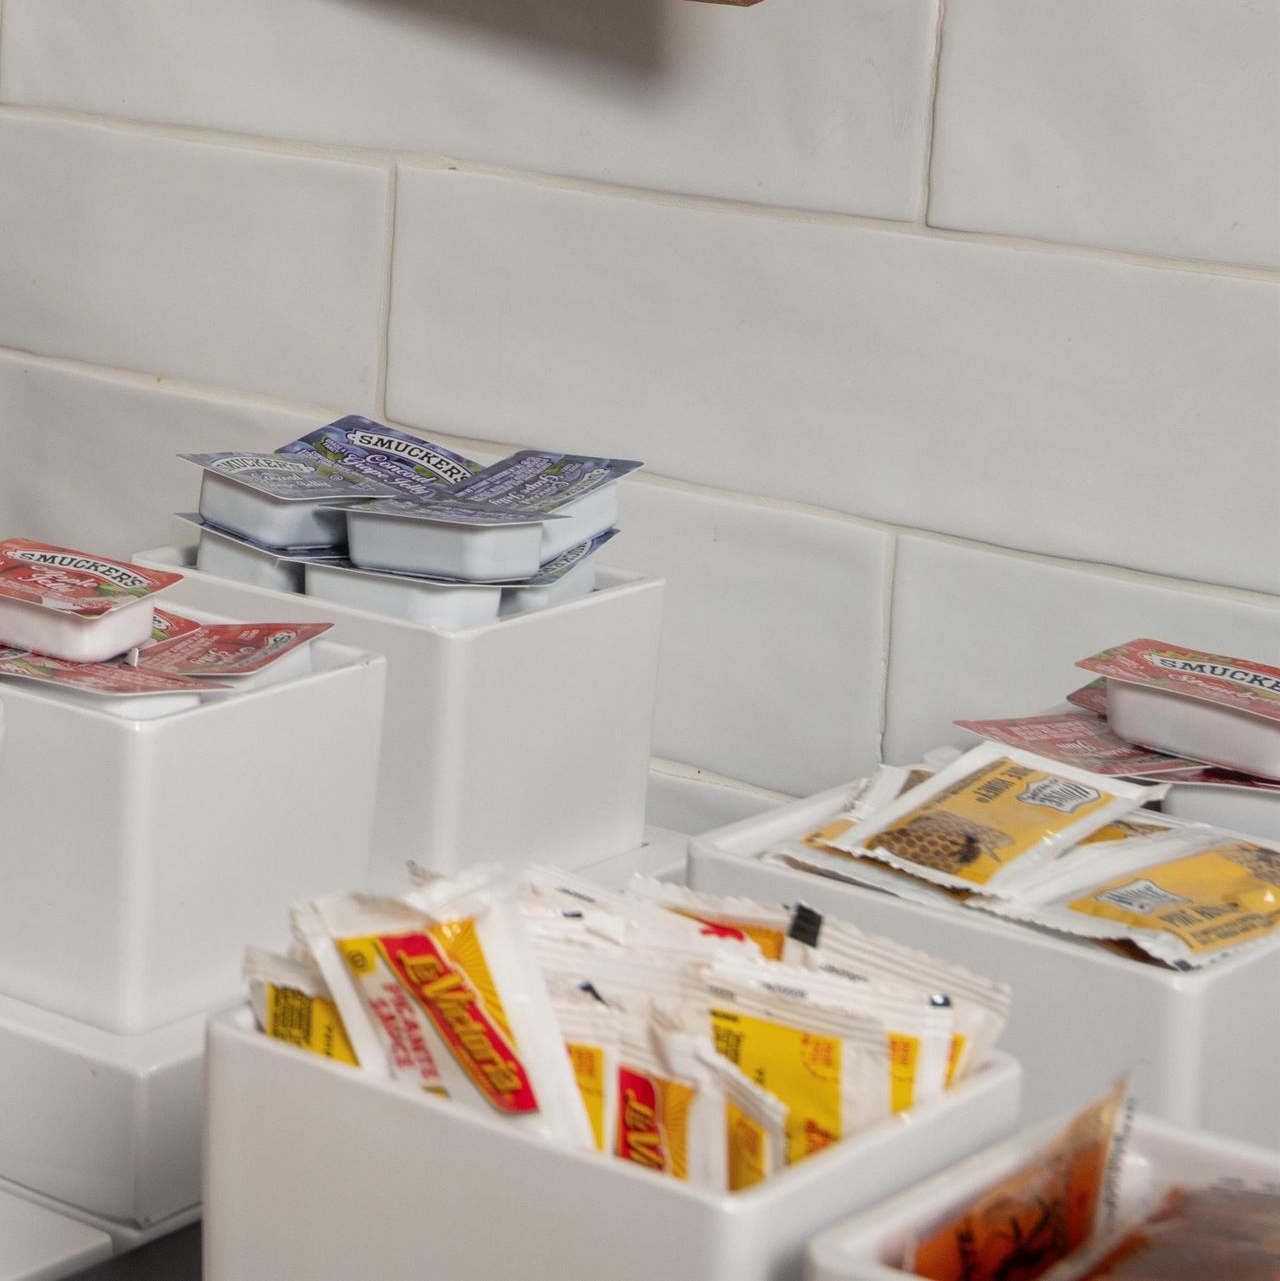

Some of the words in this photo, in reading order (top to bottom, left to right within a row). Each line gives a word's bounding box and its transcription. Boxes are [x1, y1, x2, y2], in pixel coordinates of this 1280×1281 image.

[365, 454, 436, 484] Concord
[19, 551, 144, 587] SMUCKER'S
[383, 981, 439, 1080] PICANTE
